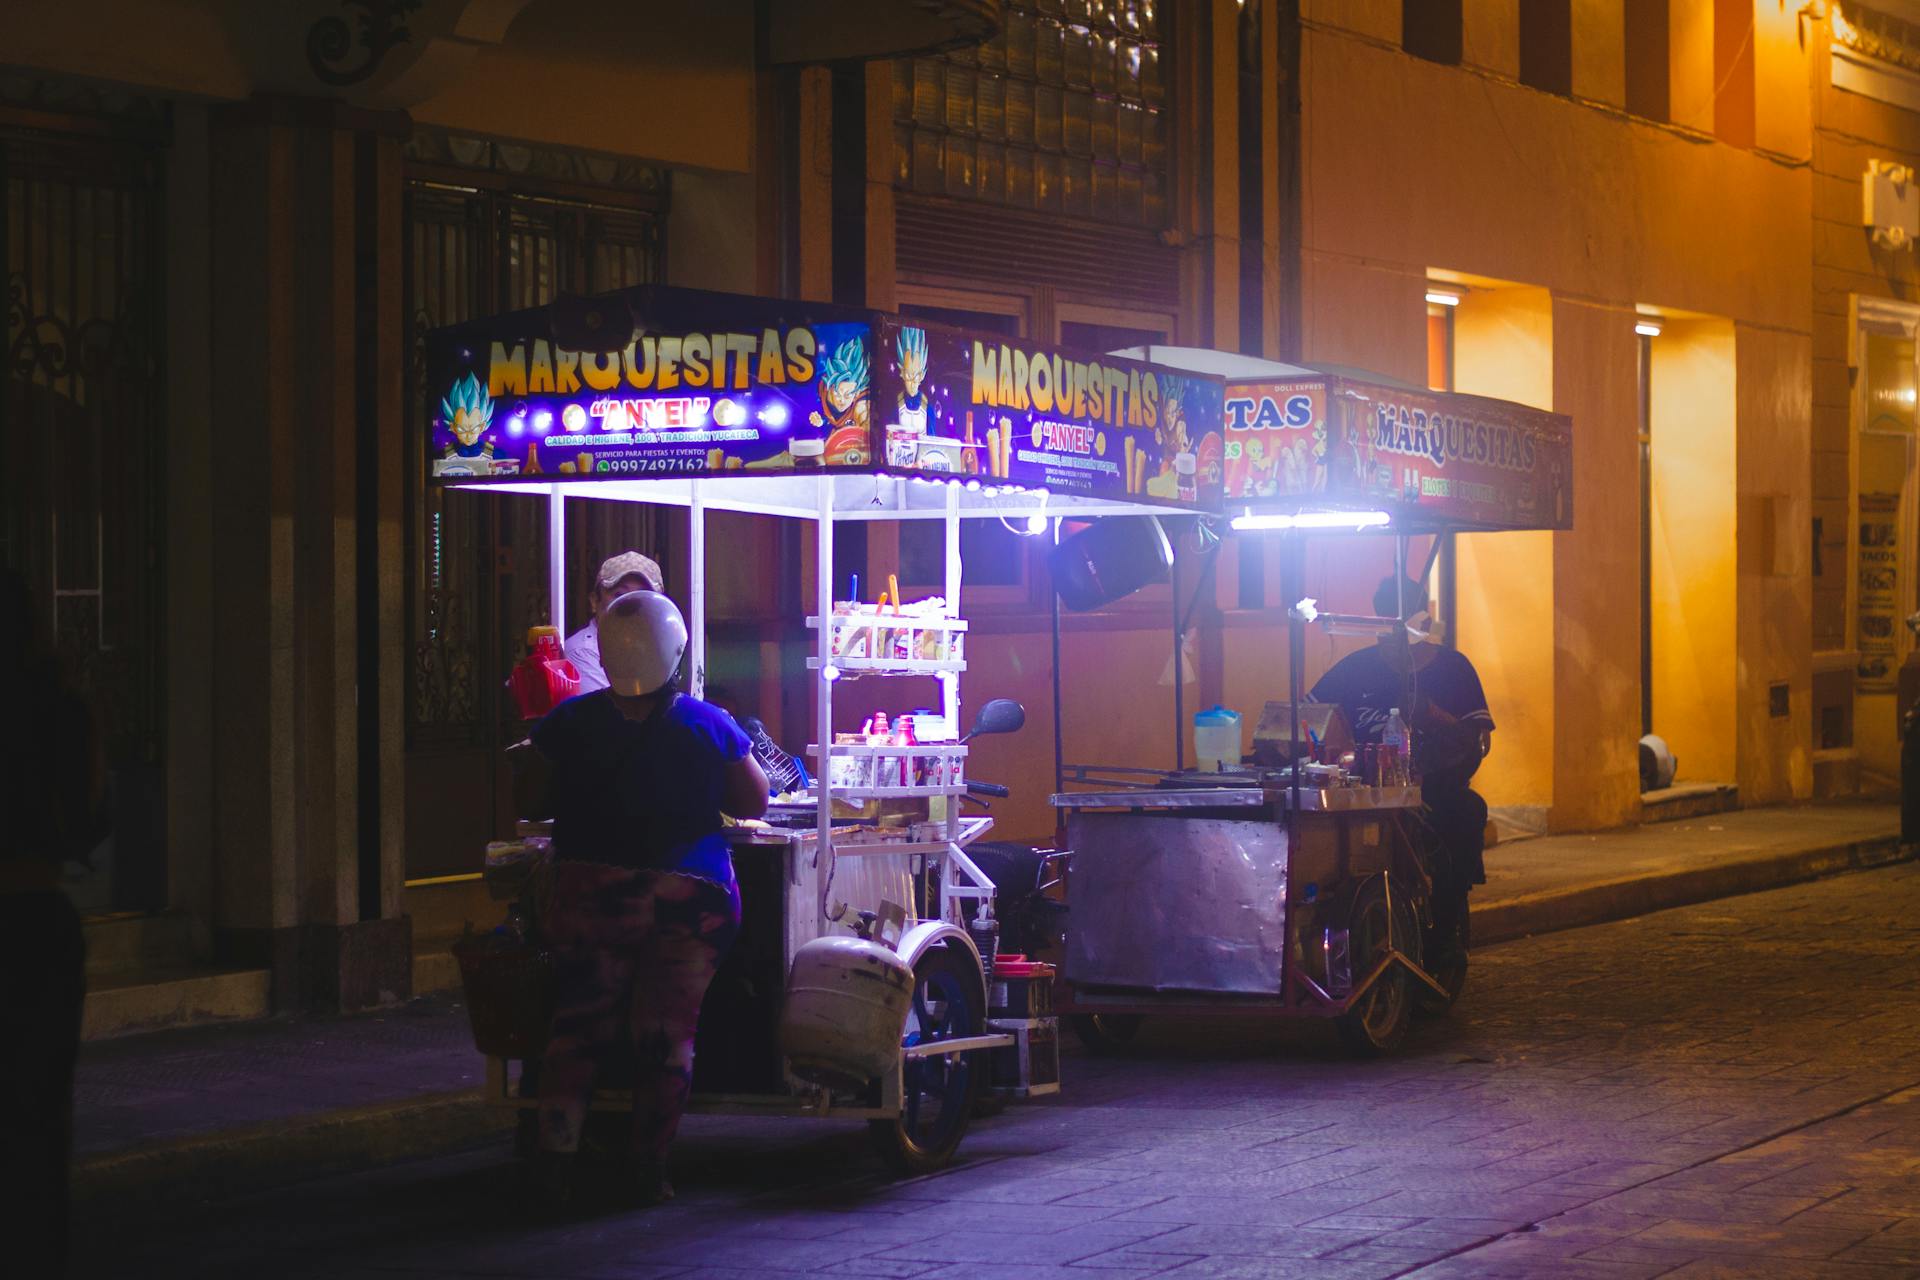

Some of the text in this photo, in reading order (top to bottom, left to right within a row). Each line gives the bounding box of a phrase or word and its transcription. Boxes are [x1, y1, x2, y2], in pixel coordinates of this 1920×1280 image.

[489, 328, 816, 397] MARQUESITAS
[972, 340, 1158, 429] MARQUESITAS
[545, 434, 585, 446] CALIDAD
[585, 434, 593, 445] E
[594, 432, 634, 446] HIGIENE,
[660, 429, 711, 443] TRADICIÓN
[711, 429, 759, 441] YUCATECA
[1225, 395, 1312, 431] TAS
[1375, 401, 1536, 472] MARQUESITAS
[595, 450, 624, 459] SERVICIO
[625, 449, 642, 457] PARA
[643, 449, 668, 457] FIESTAS
[676, 448, 706, 456] EVENTOS
